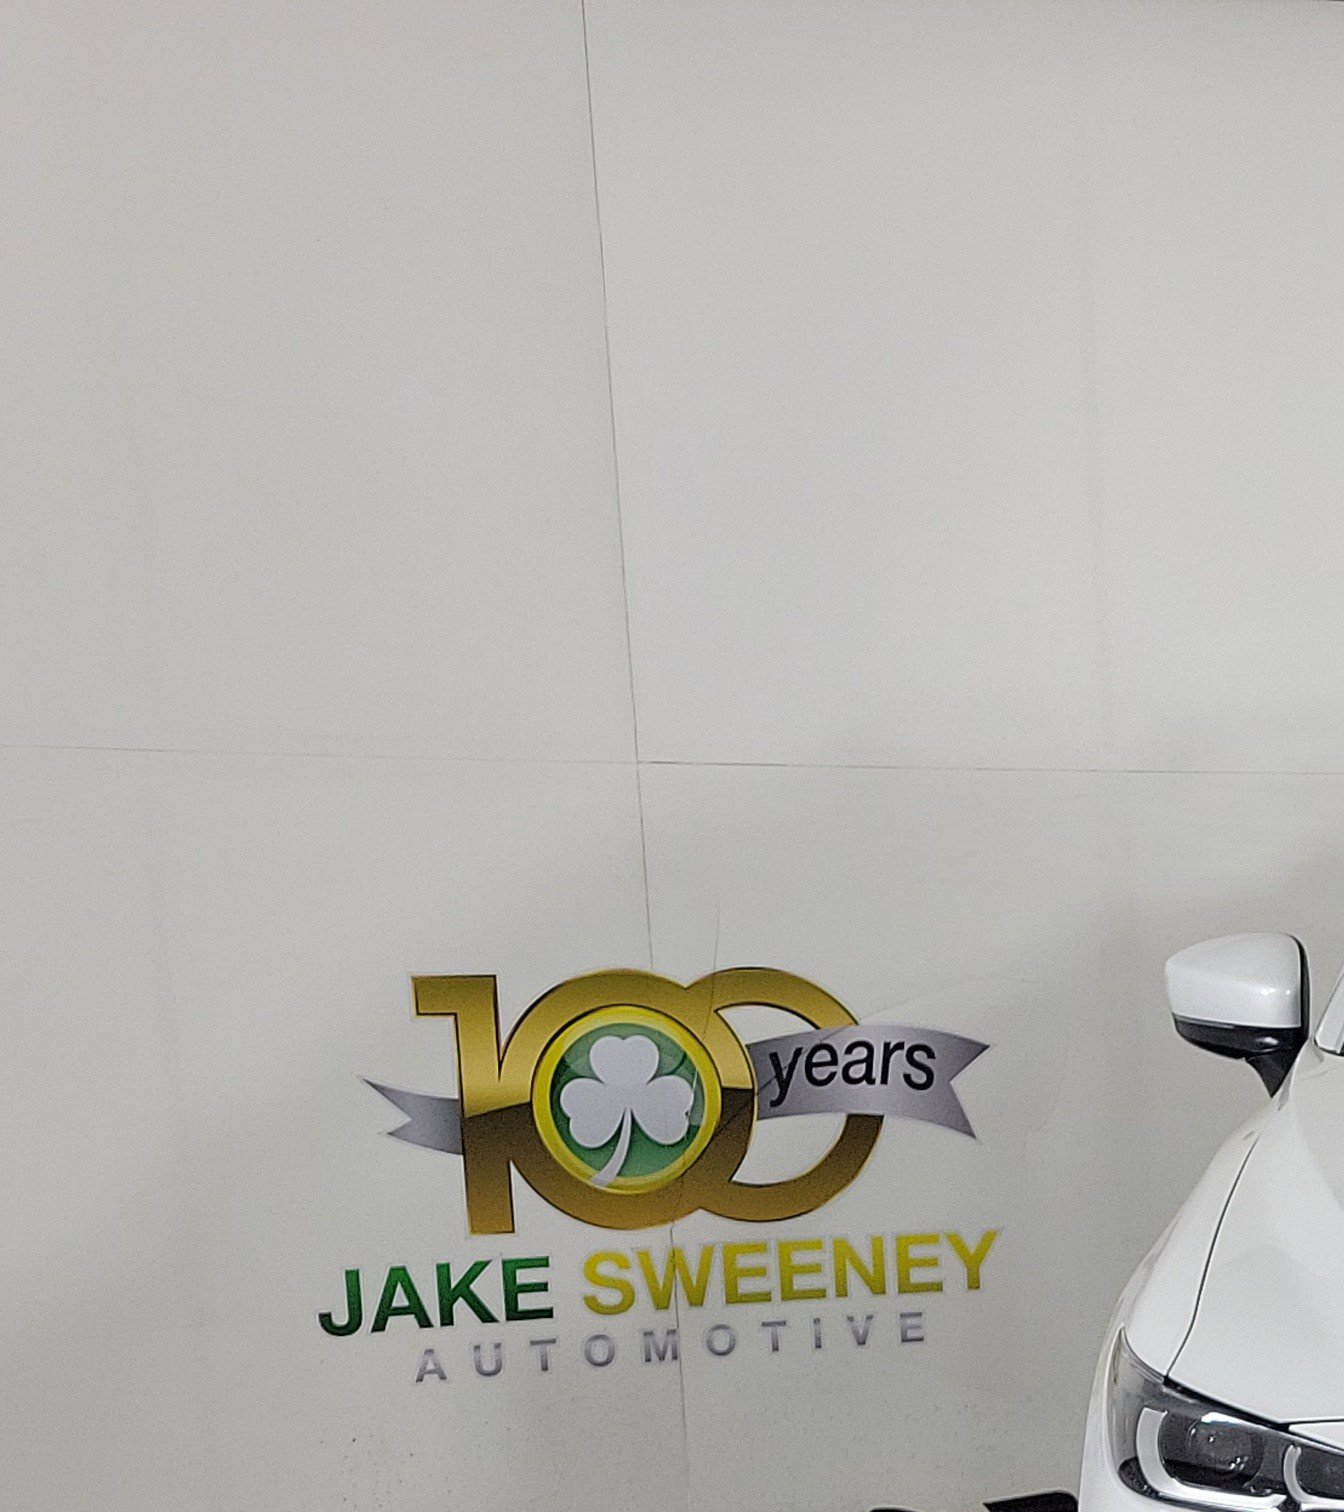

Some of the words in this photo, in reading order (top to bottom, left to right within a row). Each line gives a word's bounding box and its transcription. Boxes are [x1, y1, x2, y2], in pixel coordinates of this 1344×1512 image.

[411, 967, 885, 1234] 100
[769, 1039, 936, 1106] years
[318, 1256, 554, 1337] JAKE
[582, 1229, 1000, 1315] SWEENEY
[415, 1312, 926, 1383] AUTOMOTIVE
